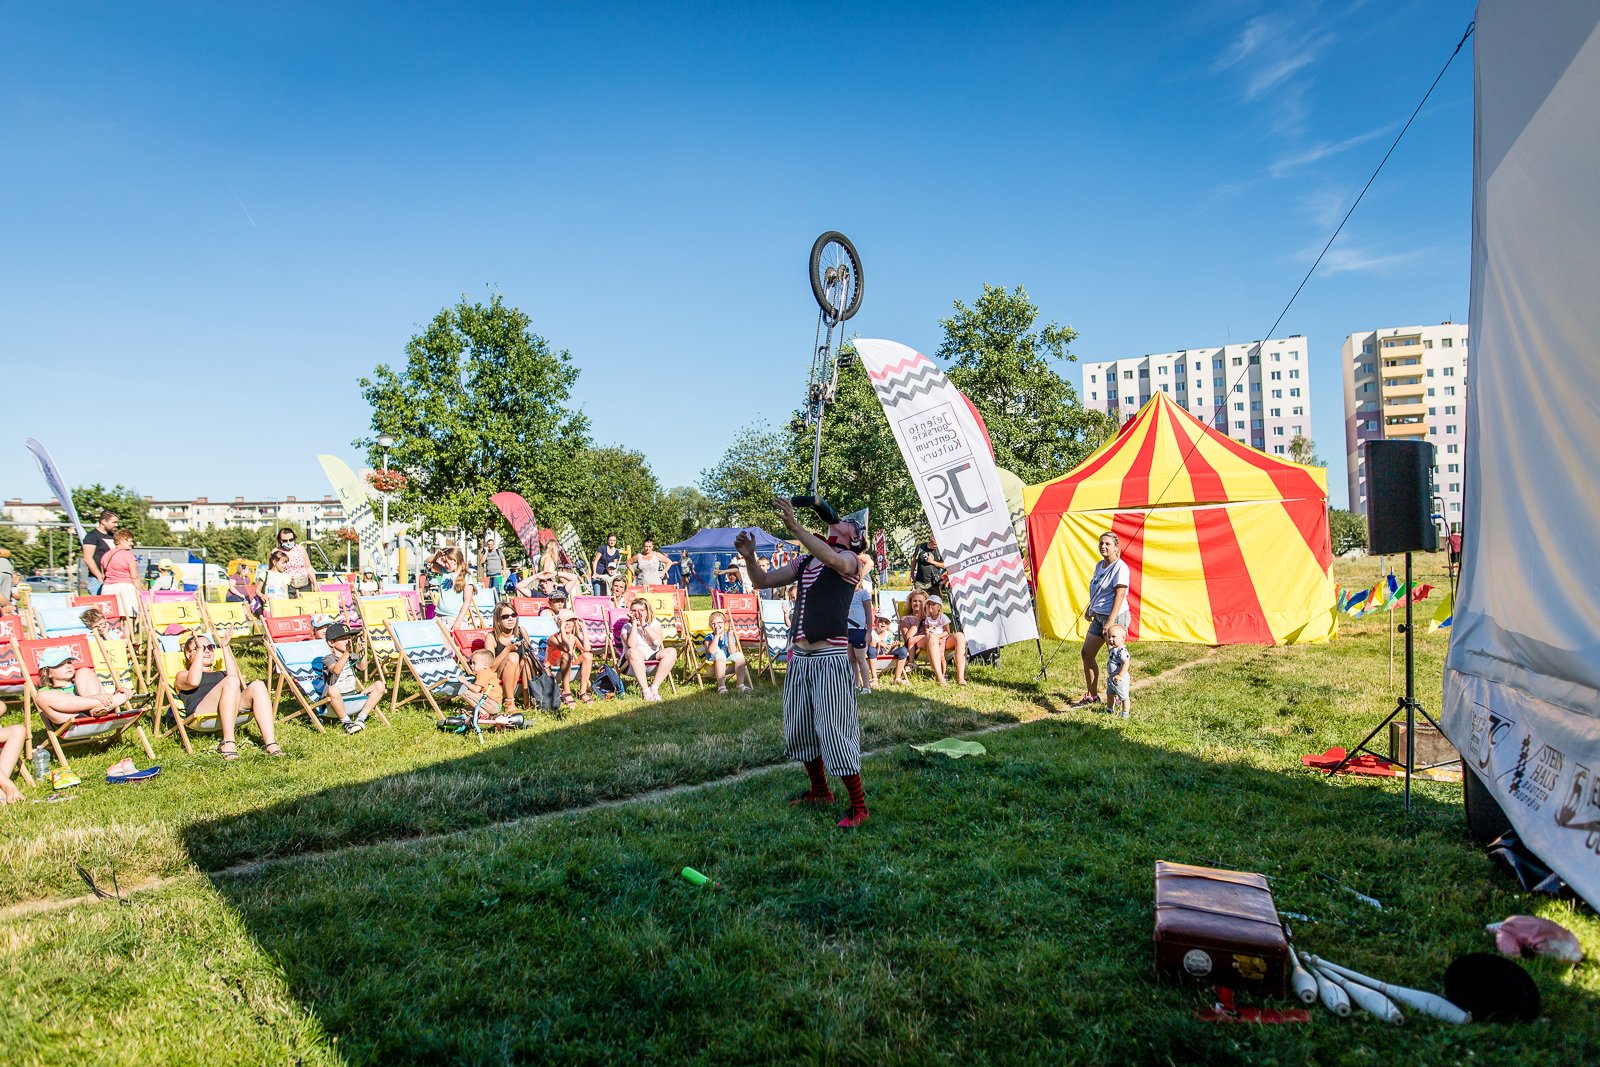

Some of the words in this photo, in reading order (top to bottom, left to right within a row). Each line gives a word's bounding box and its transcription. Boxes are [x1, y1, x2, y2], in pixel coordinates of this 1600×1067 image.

[1540, 745, 1566, 773] STEIN
[1521, 780, 1549, 802] BAUTZEN
[1530, 764, 1560, 792] HAUS
